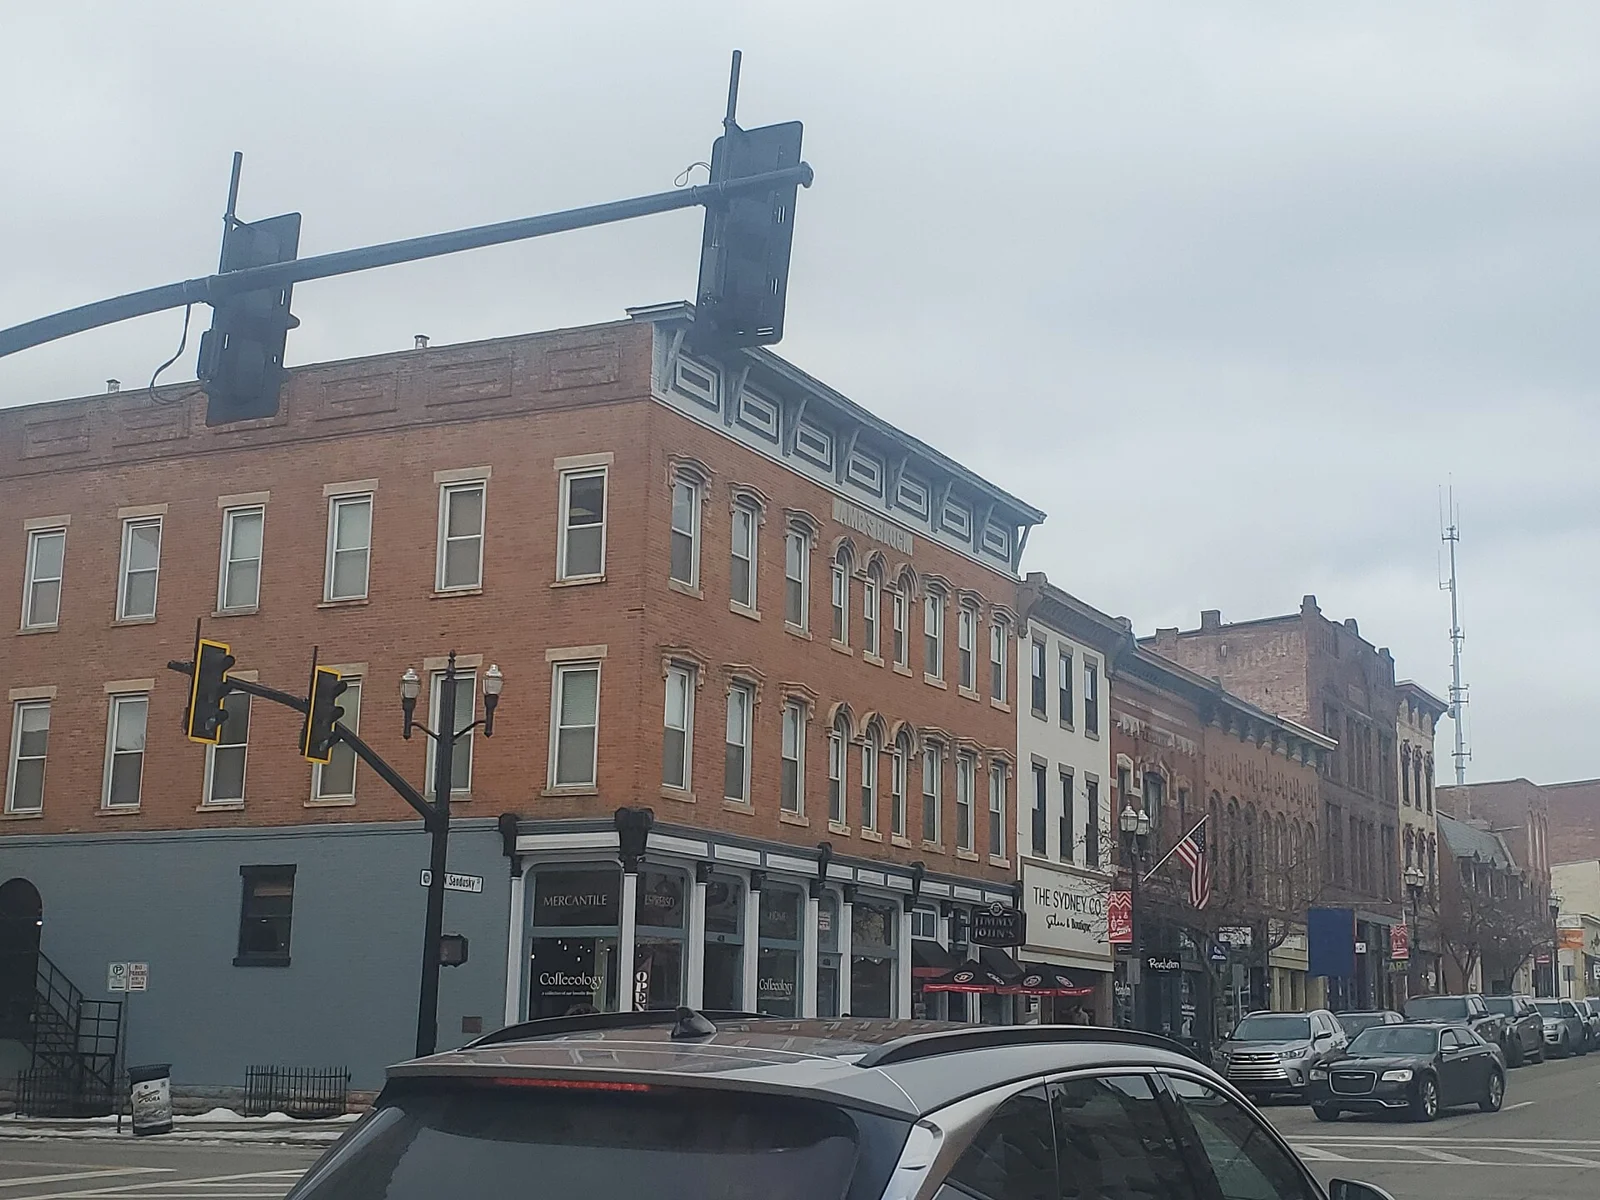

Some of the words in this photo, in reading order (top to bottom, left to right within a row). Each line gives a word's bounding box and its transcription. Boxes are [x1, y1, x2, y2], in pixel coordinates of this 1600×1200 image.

[449, 875, 475, 890] Sandusky
[543, 894, 608, 907] MERCANTILE
[644, 894, 675, 908] ESPRESSO
[1033, 886, 1051, 907] THE
[1053, 890, 1088, 914] SYDNEY
[974, 917, 1014, 927] JIMMY
[975, 928, 1015, 939] JOHN'S
[1388, 960, 1408, 972] ART
[540, 972, 604, 990] Coffeeology
